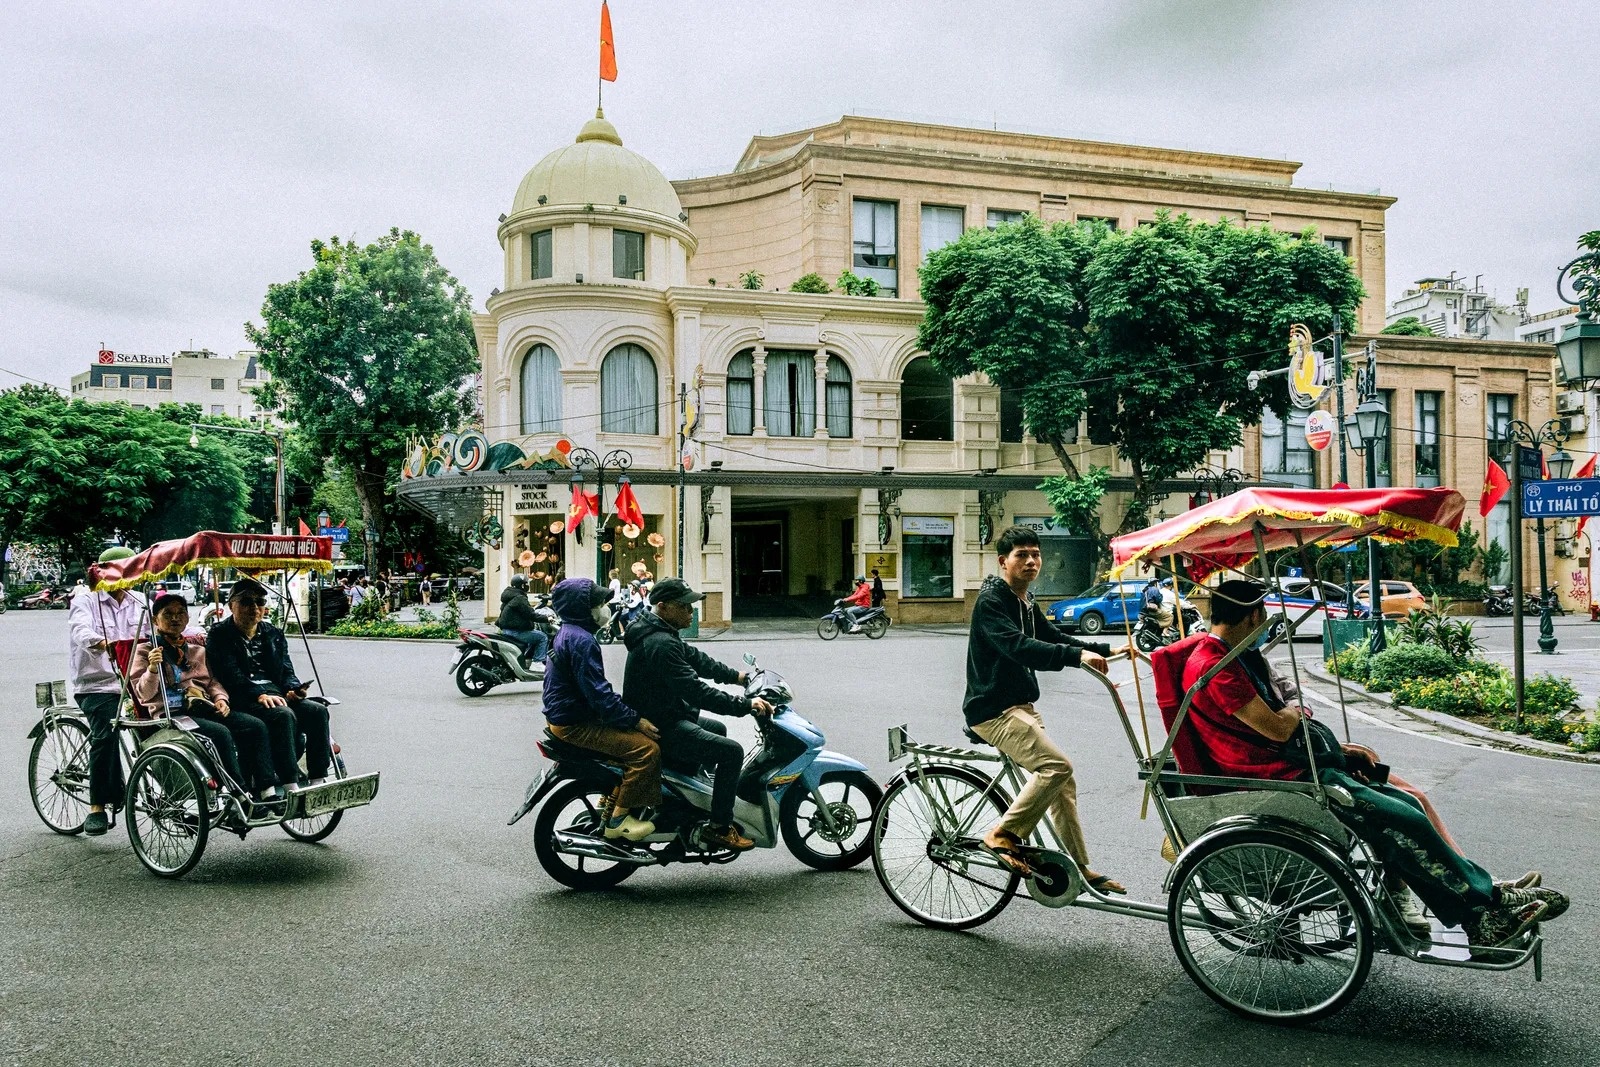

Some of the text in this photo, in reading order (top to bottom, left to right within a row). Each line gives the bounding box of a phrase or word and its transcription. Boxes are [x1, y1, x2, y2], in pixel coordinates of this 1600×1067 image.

[117, 353, 170, 365] SeABank
[1310, 424, 1324, 433] Bank
[1557, 482, 1583, 493] PHỐ
[521, 491, 547, 500] STOCK
[515, 500, 558, 510] EXCHANGE
[1529, 492, 1600, 513] LÝ THÁI TỔ
[268, 541, 296, 555] TRUNG
[297, 538, 317, 556] HIẾU
